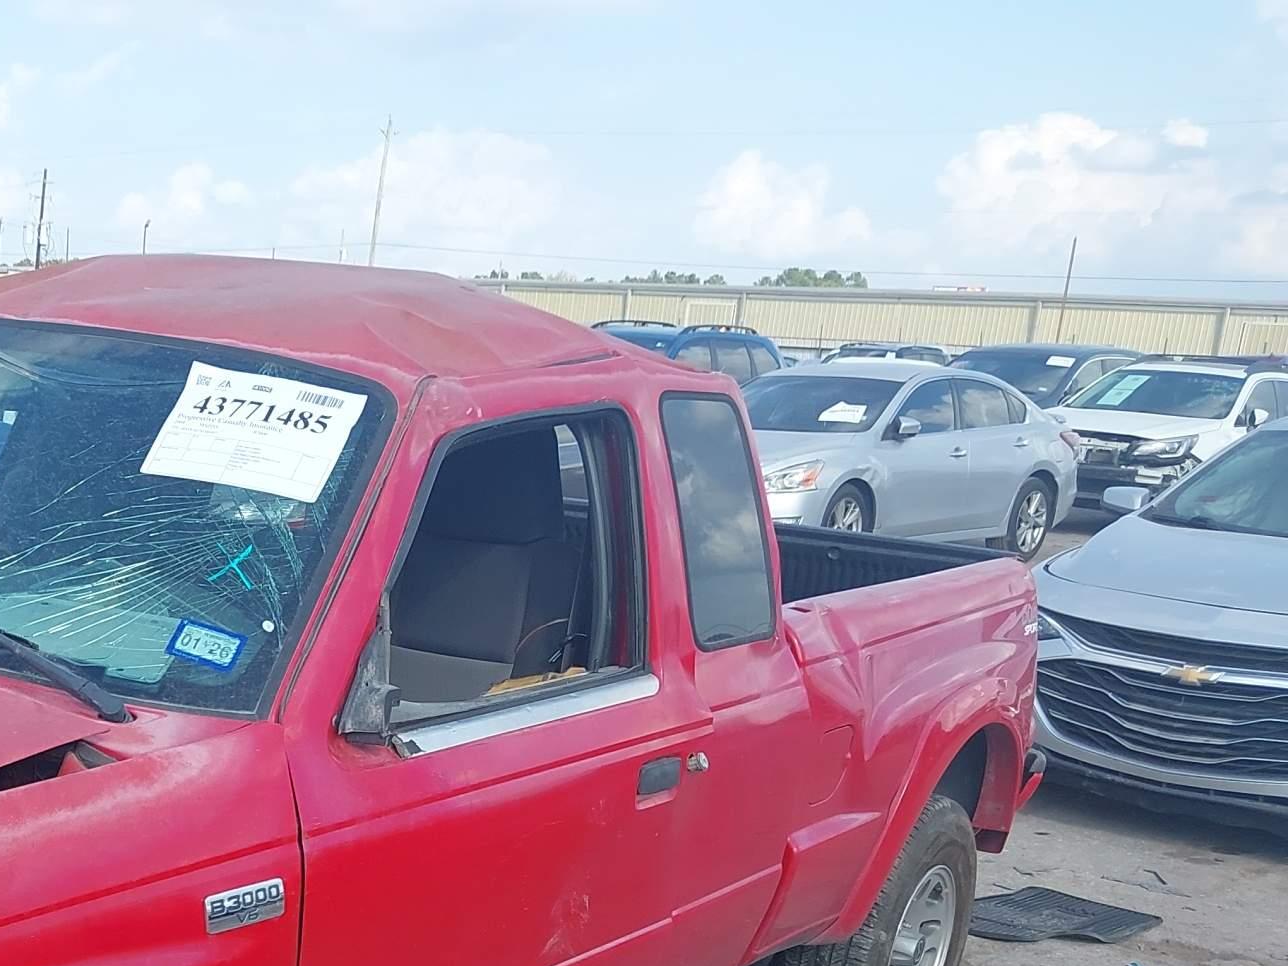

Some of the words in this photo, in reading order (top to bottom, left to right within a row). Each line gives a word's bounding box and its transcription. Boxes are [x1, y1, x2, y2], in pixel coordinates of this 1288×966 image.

[193, 395, 333, 434] 43771485
[180, 633, 201, 650] 01
[207, 642, 232, 659] 26
[209, 883, 280, 916] B3000
